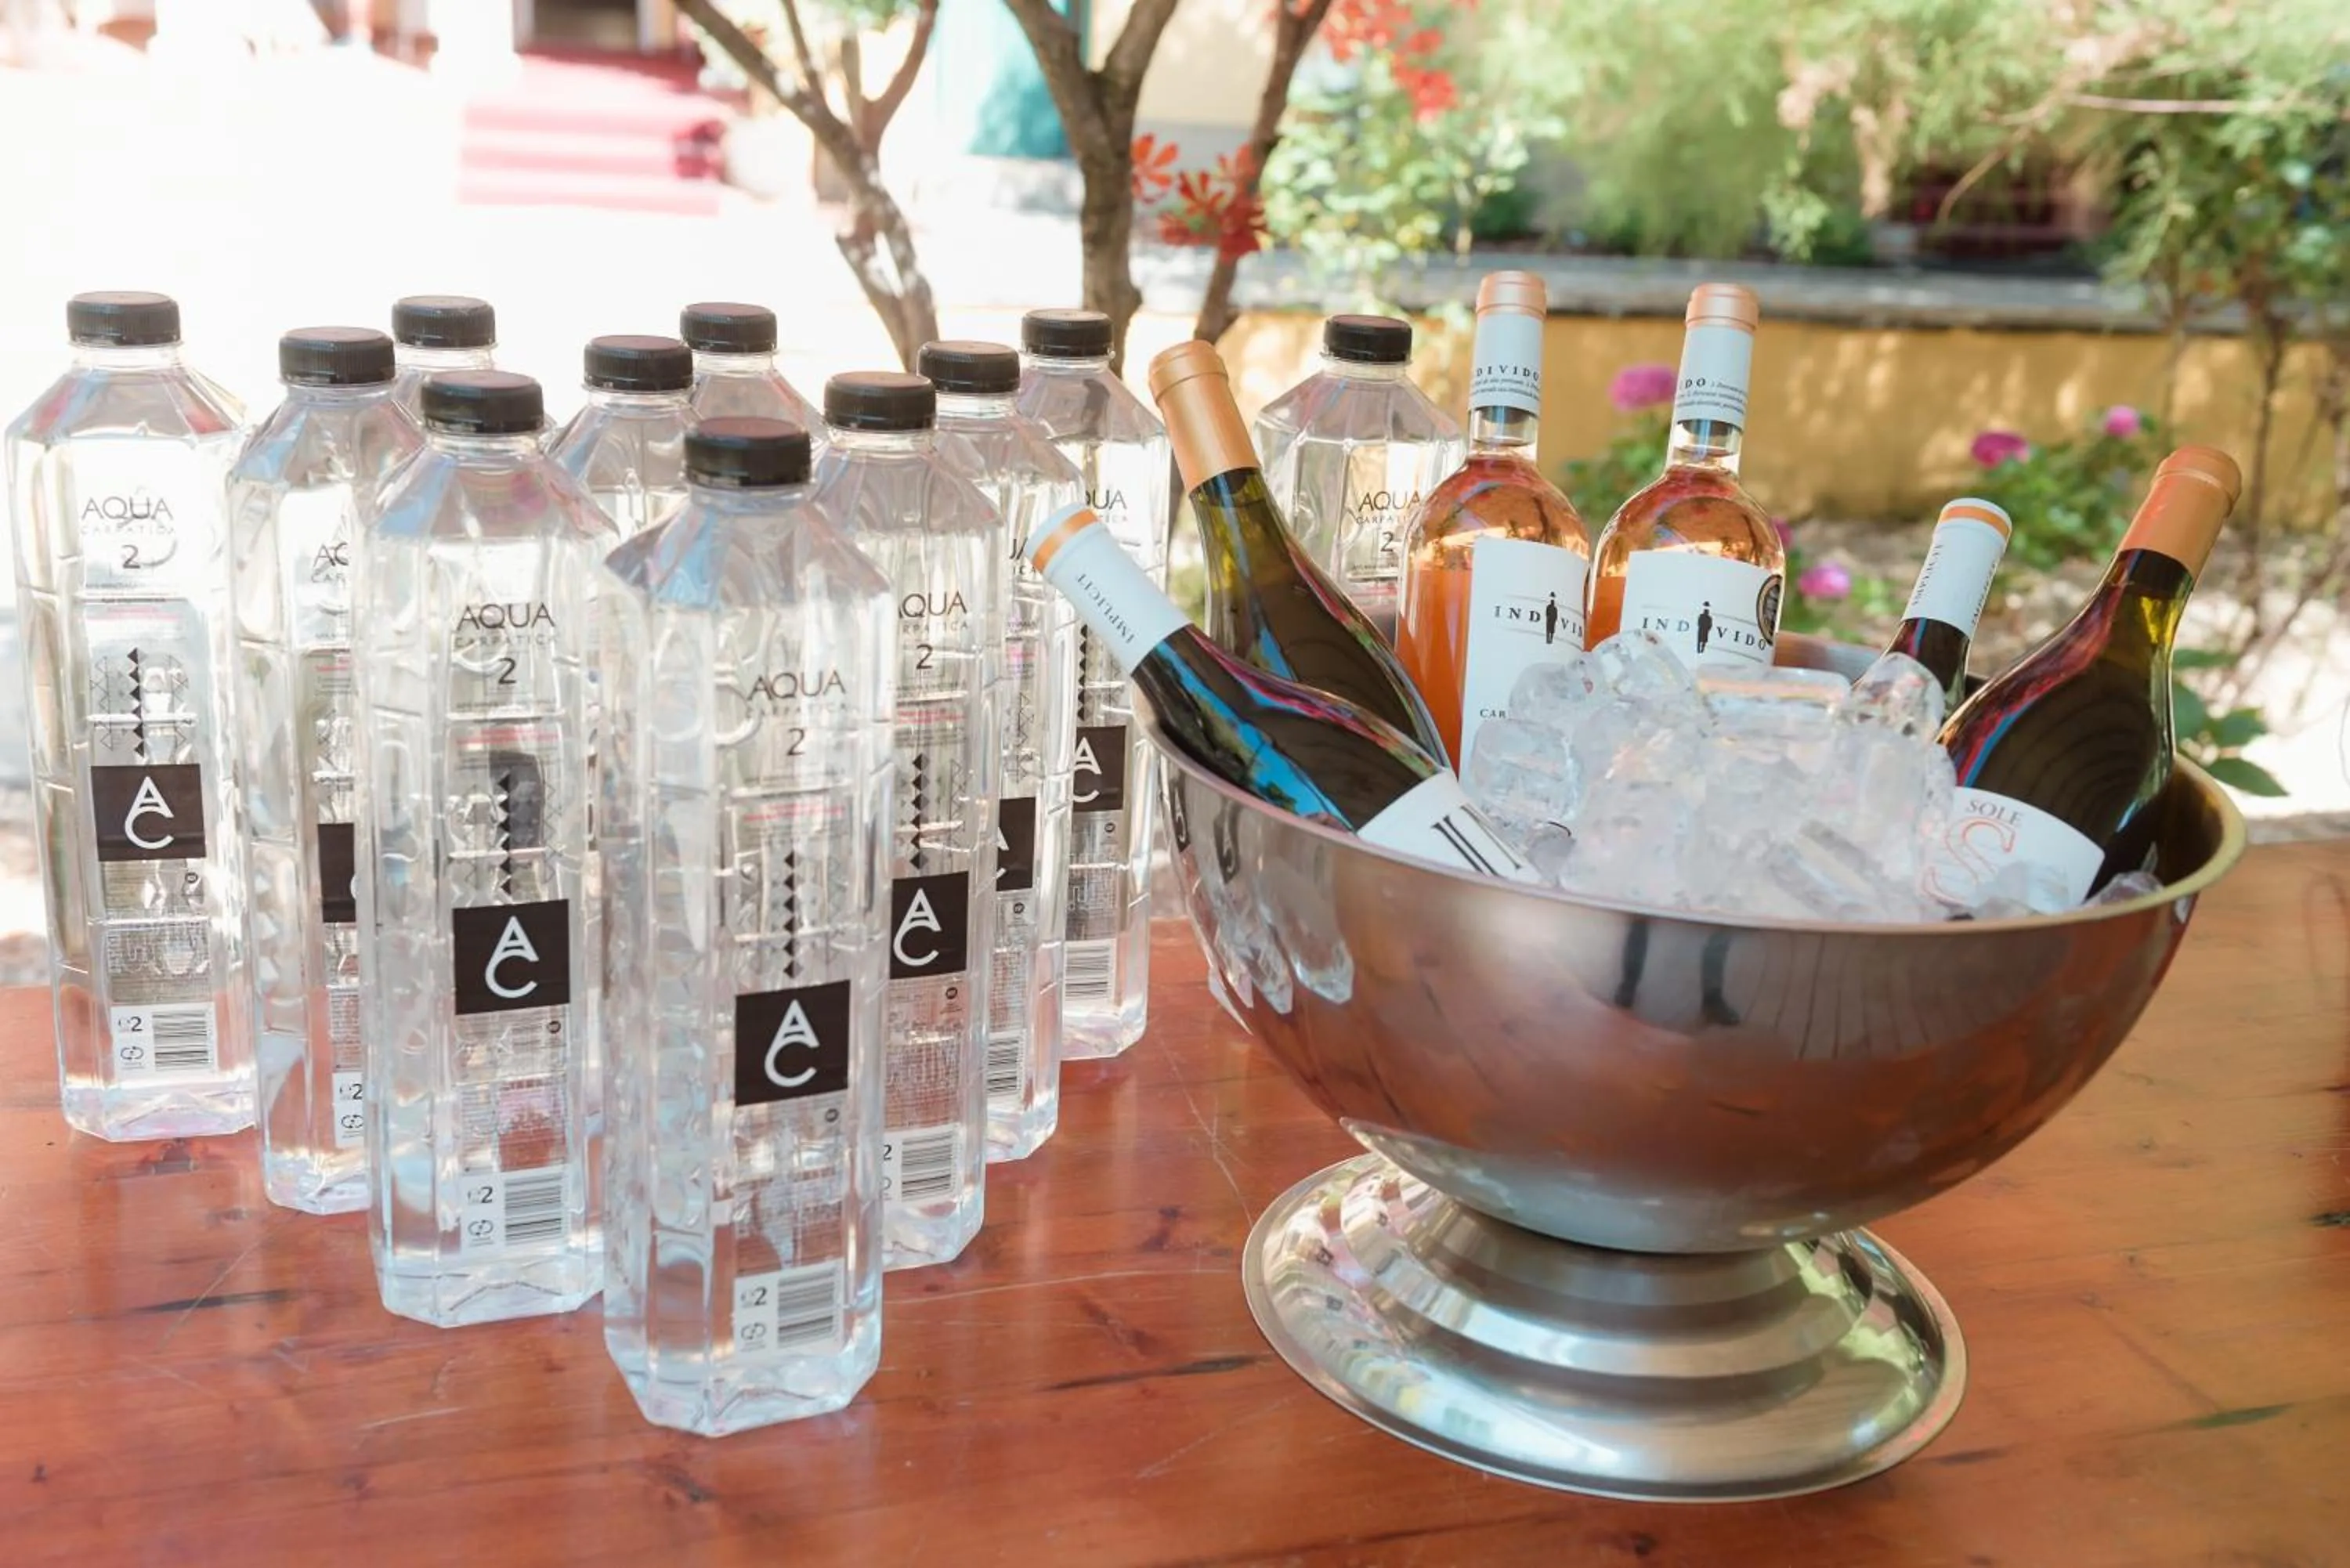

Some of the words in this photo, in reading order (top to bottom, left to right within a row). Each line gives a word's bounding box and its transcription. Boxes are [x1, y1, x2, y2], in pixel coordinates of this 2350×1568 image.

[81, 496, 174, 521] AQUA
[1358, 490, 1421, 511] AQUA
[1379, 530, 1394, 552] 2
[121, 544, 141, 569] 2
[457, 602, 556, 630] AQUA
[1076, 572, 1136, 645] IMPLICIT
[916, 643, 933, 670] 2
[497, 656, 517, 685] 2
[747, 670, 847, 701] AQUA
[786, 727, 805, 757] 2
